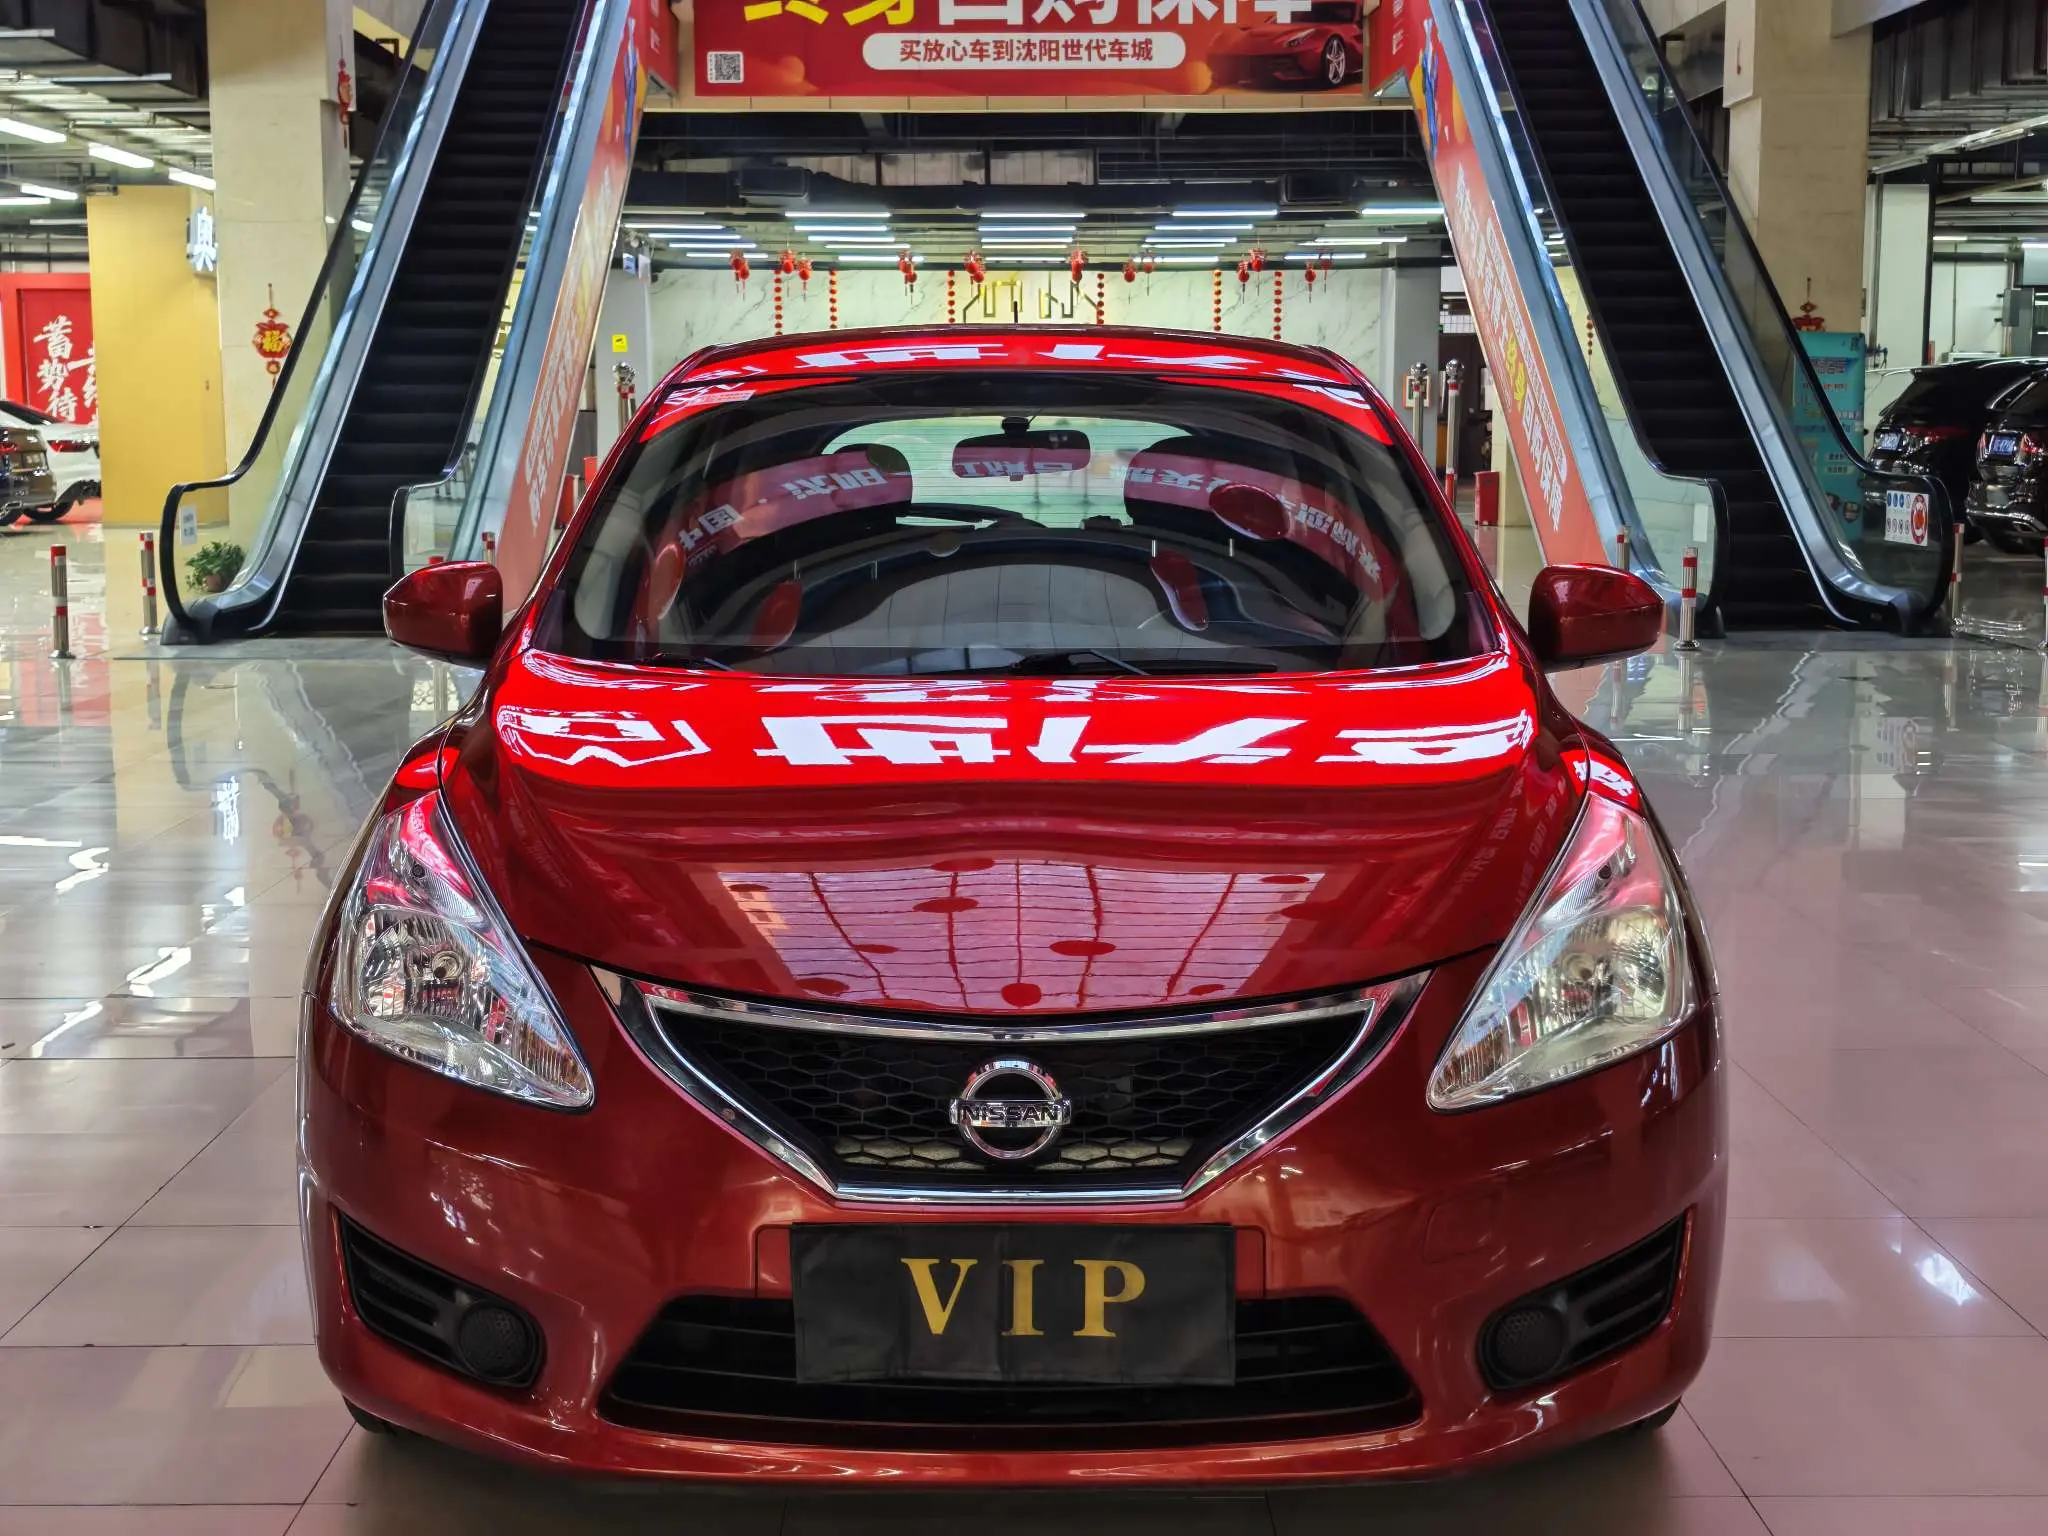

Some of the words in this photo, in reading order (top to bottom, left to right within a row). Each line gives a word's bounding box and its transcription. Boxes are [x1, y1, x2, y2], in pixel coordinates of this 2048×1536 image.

[900, 38, 1153, 62] 买放心车到沈阳世代车城
[960, 1104, 1060, 1122] NISSAN
[900, 1257, 1147, 1338] VIP
